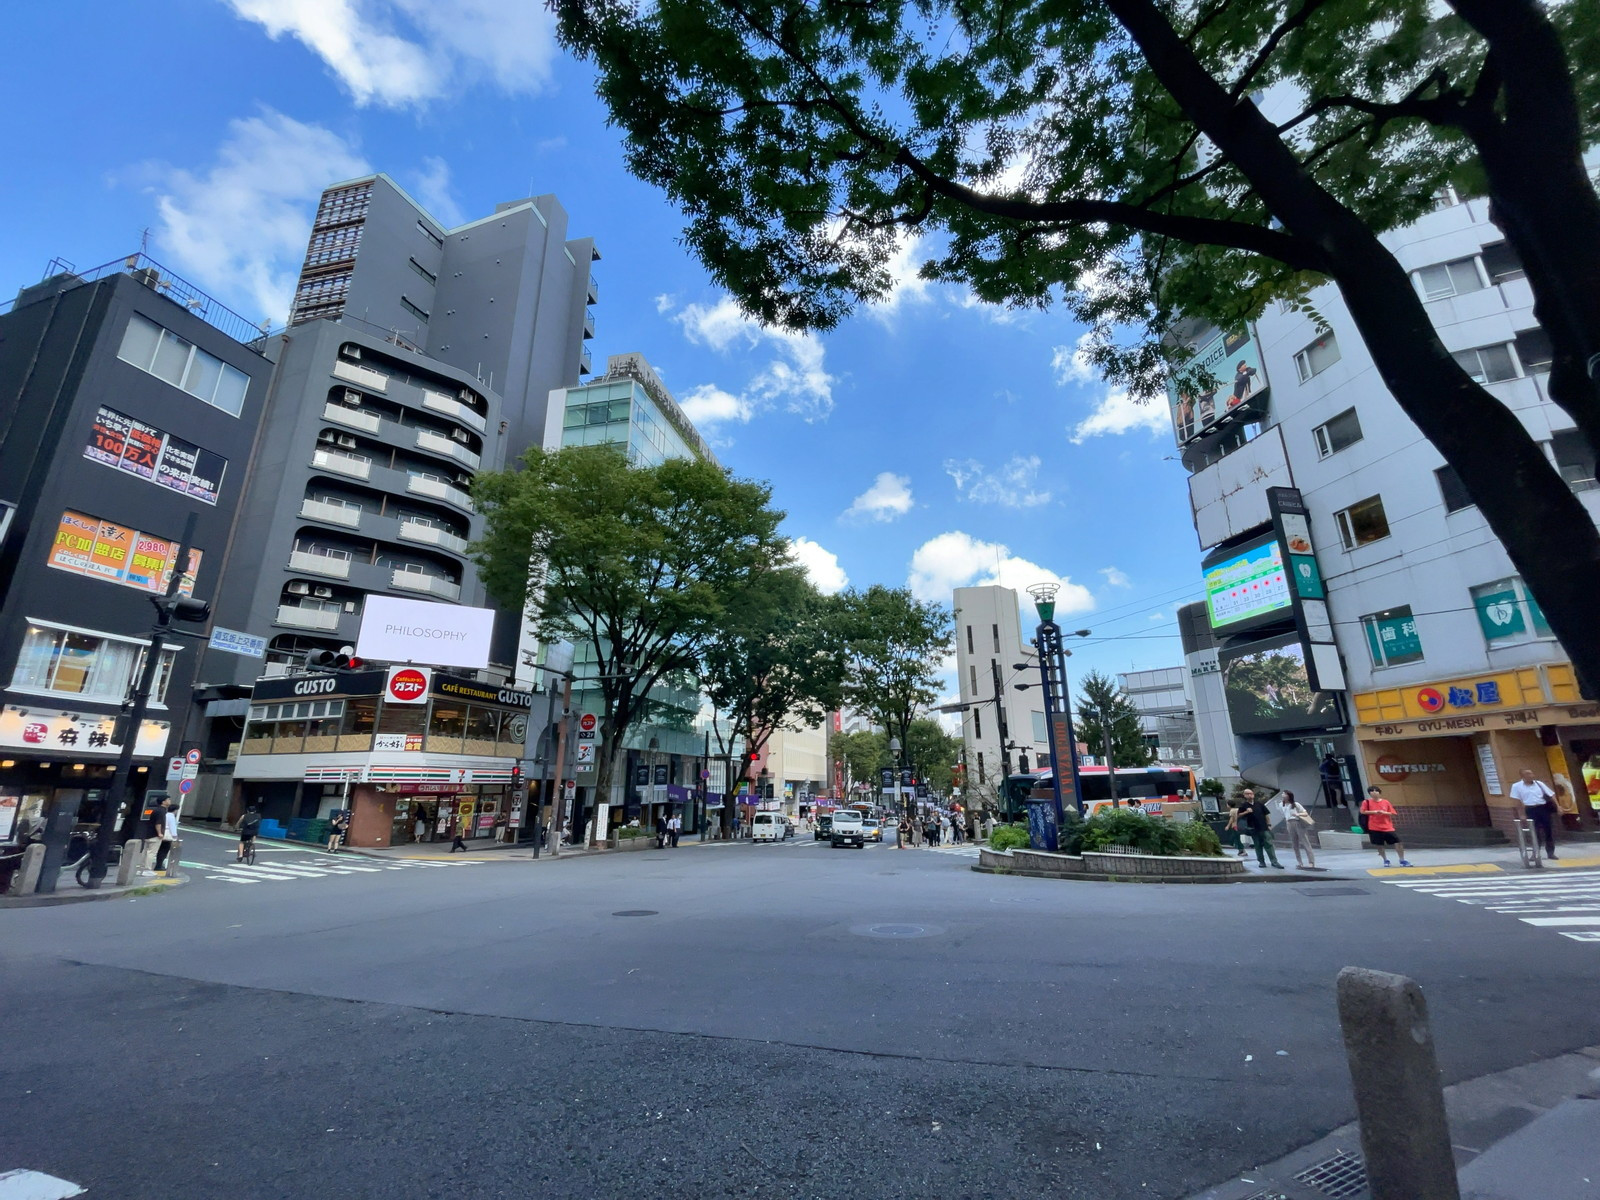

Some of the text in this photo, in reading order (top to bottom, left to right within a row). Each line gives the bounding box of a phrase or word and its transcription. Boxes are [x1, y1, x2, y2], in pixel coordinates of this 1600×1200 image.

[385, 624, 468, 641] PHILOSOPHY
[1381, 621, 1417, 642] 歯科
[294, 678, 336, 695] GUSTO
[394, 682, 423, 692] ガスト
[441, 683, 532, 706] CAFÉ RESTAURANT GUSTO
[1447, 681, 1501, 708] 松屋
[1375, 725, 1403, 736] 牛めし
[1418, 717, 1484, 732] GYU-MESHI
[57, 727, 122, 748] 麻辣
[1055, 722, 1074, 795] DOGENZAKA
[1379, 762, 1446, 774] MATSUYA
